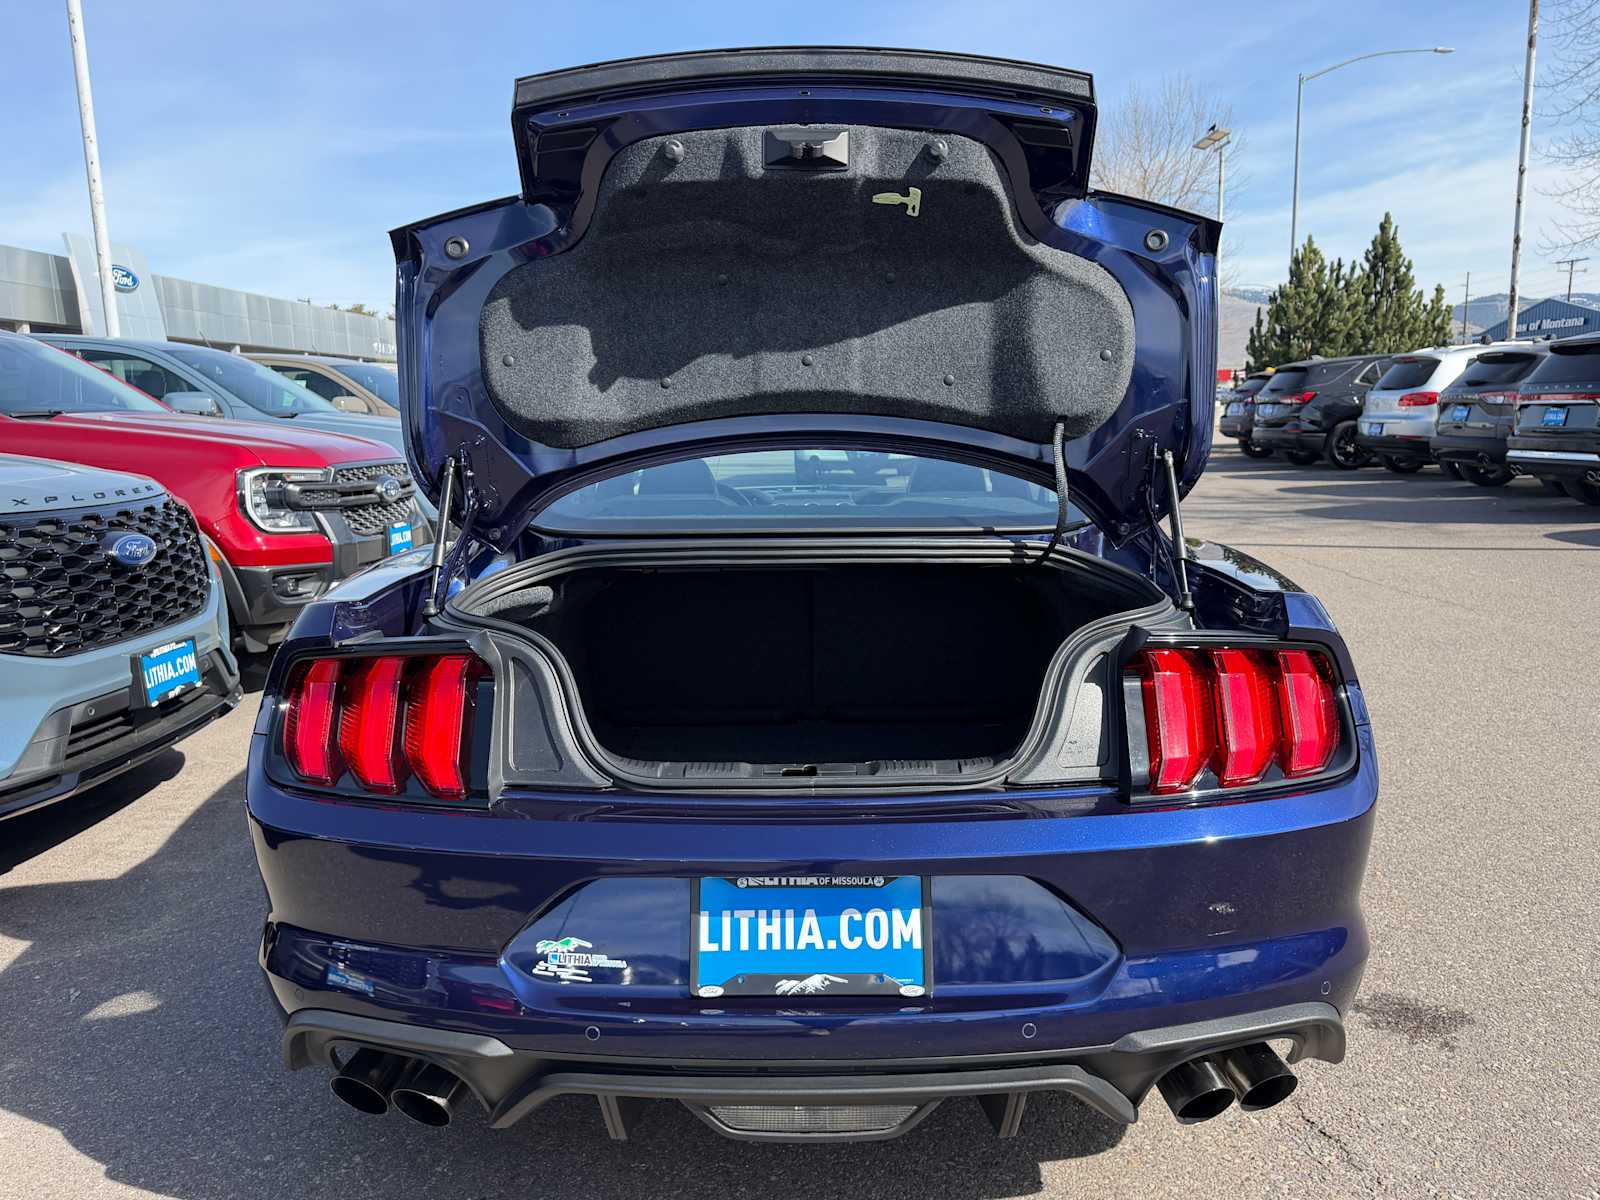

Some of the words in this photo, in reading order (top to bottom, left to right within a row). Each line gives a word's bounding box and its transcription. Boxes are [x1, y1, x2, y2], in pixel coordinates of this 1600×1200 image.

[113, 269, 133, 287] Ford
[1529, 320, 1540, 331] of
[1542, 317, 1584, 330] Montana
[125, 540, 149, 558] Ford
[144, 652, 197, 689] LITHIA.COM
[819, 876, 830, 886] OF
[832, 876, 874, 886] MISSOULA
[699, 908, 922, 952] LITHIA.COM
[559, 952, 592, 965] LITHIA
